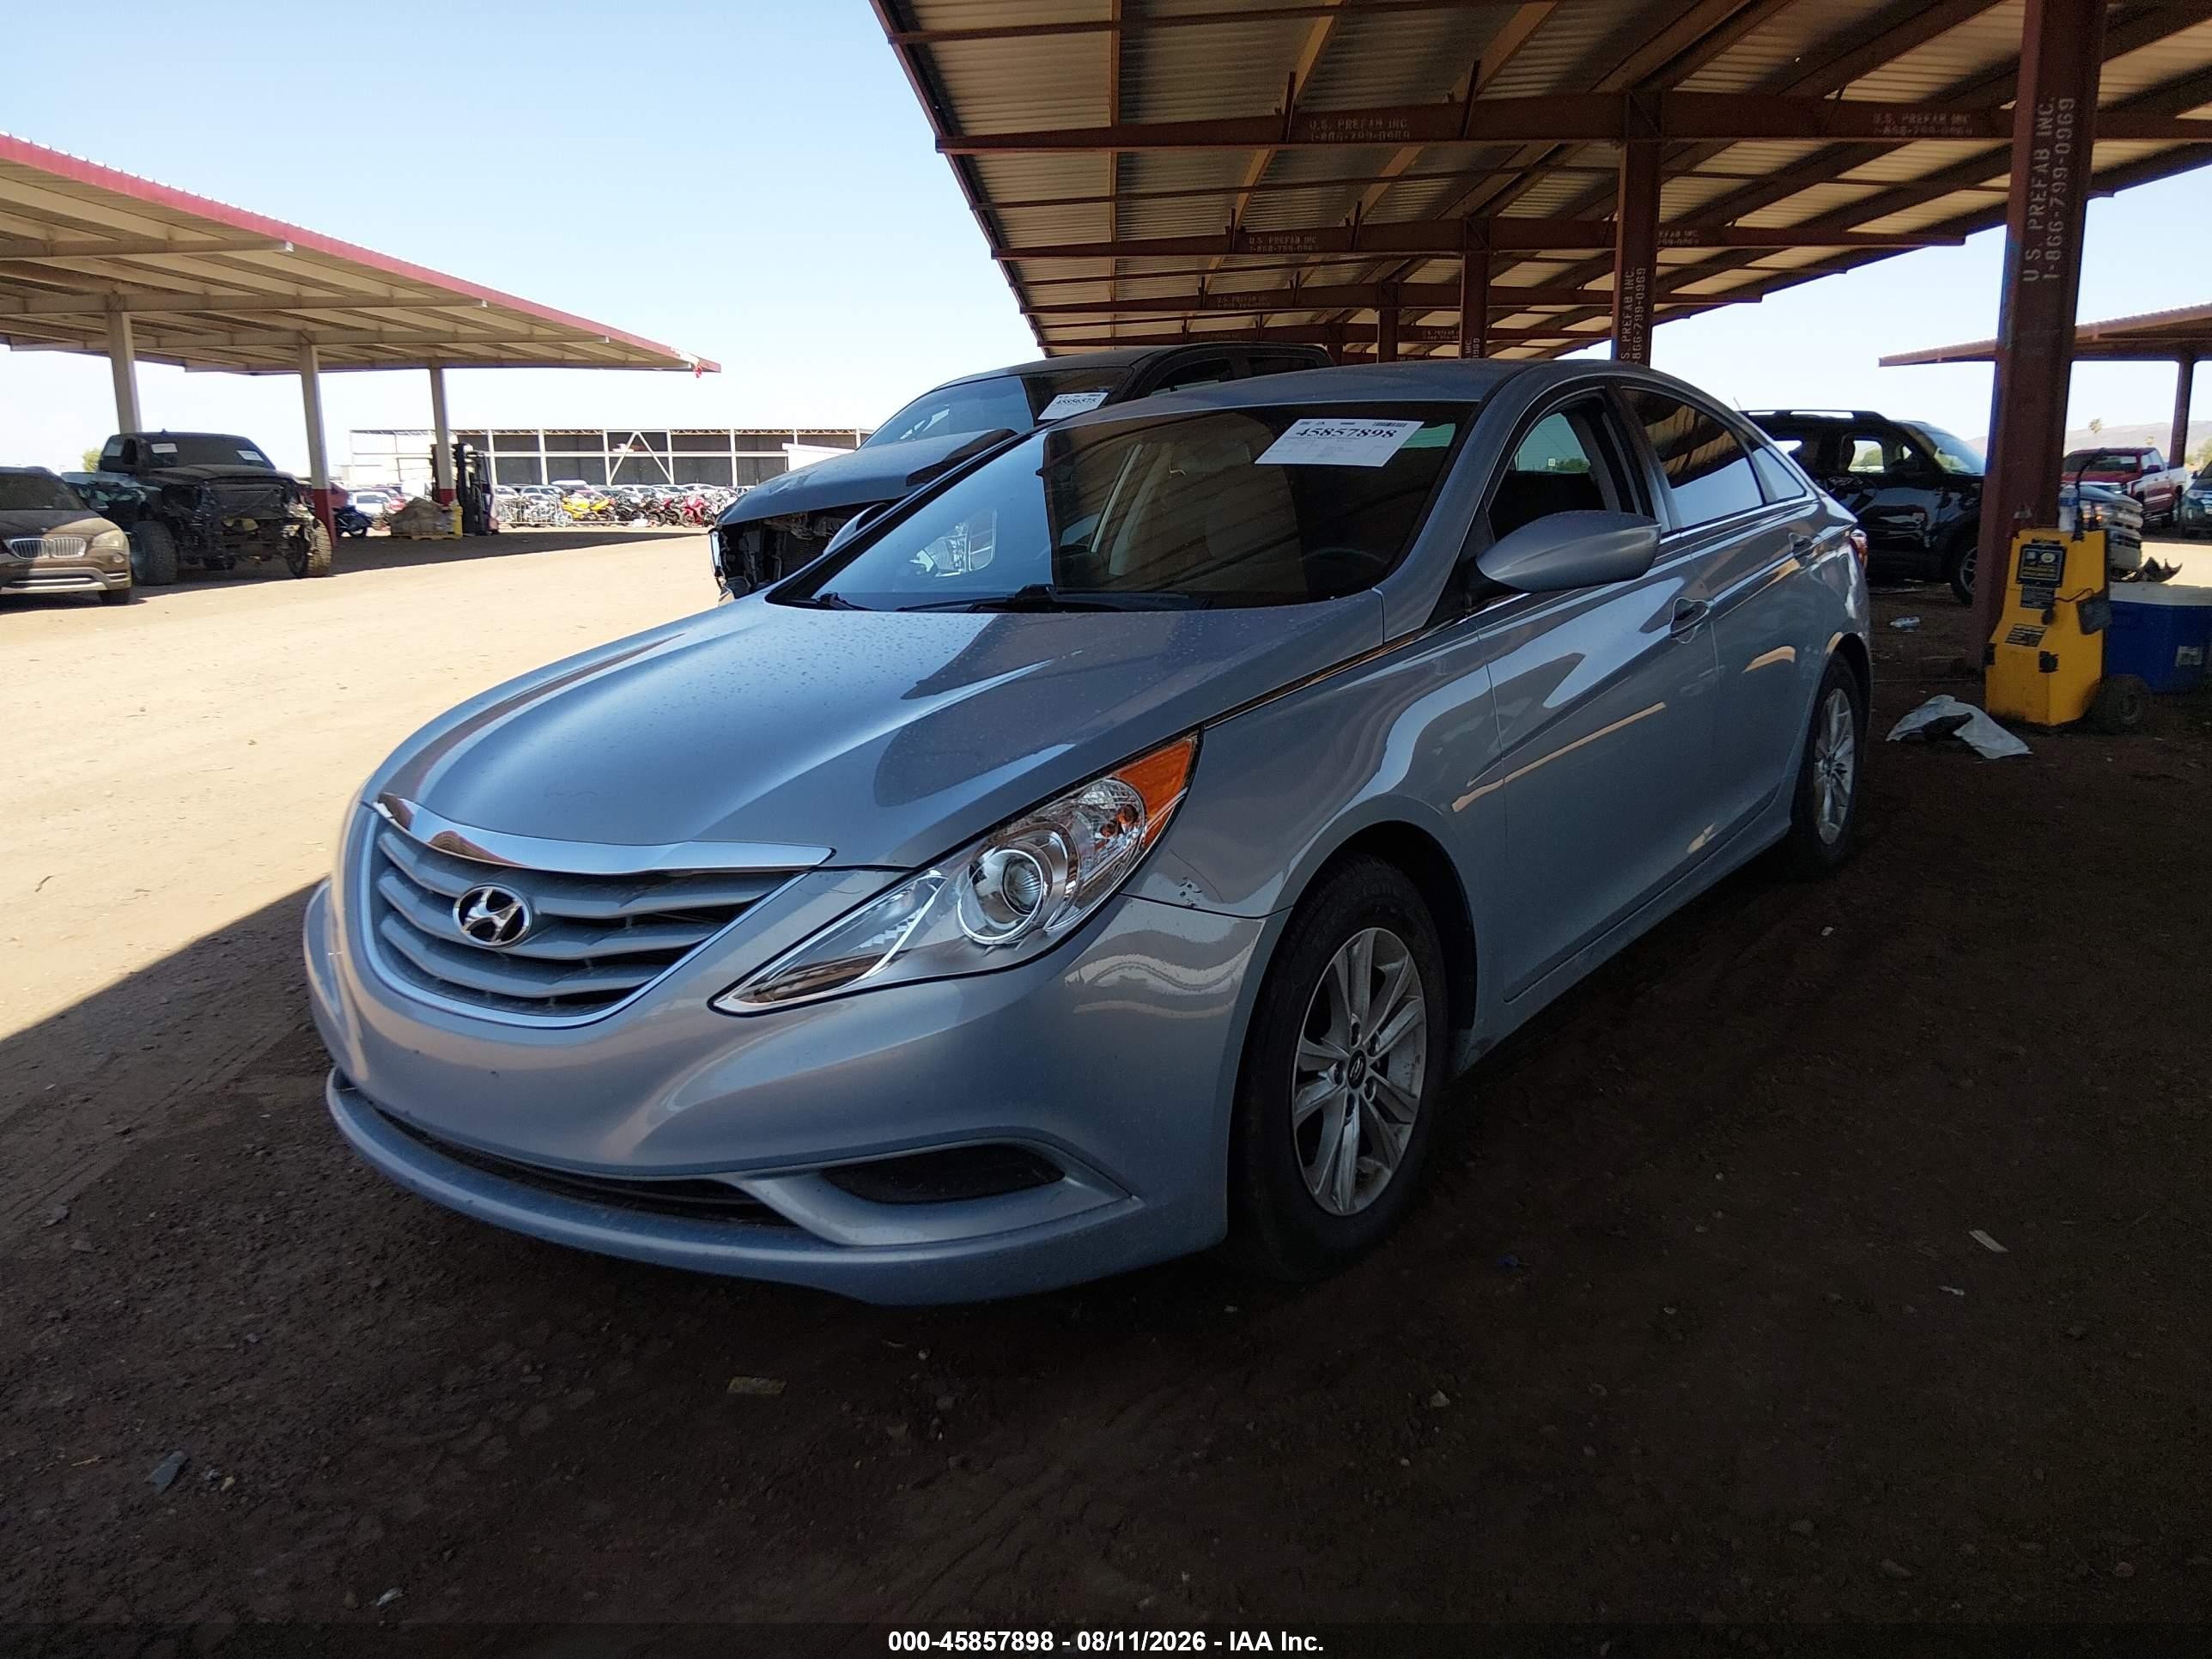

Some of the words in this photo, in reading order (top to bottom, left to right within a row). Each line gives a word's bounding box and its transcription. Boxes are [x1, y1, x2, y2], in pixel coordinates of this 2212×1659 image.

[2035, 97, 2055, 137] INC.
[2027, 148, 2050, 230] PREFAB
[2043, 98, 2075, 279] 1-866-799-0969
[1623, 267, 1635, 289] INC.
[1621, 295, 1633, 342] PREFAB
[1296, 428, 1397, 439] 45857898
